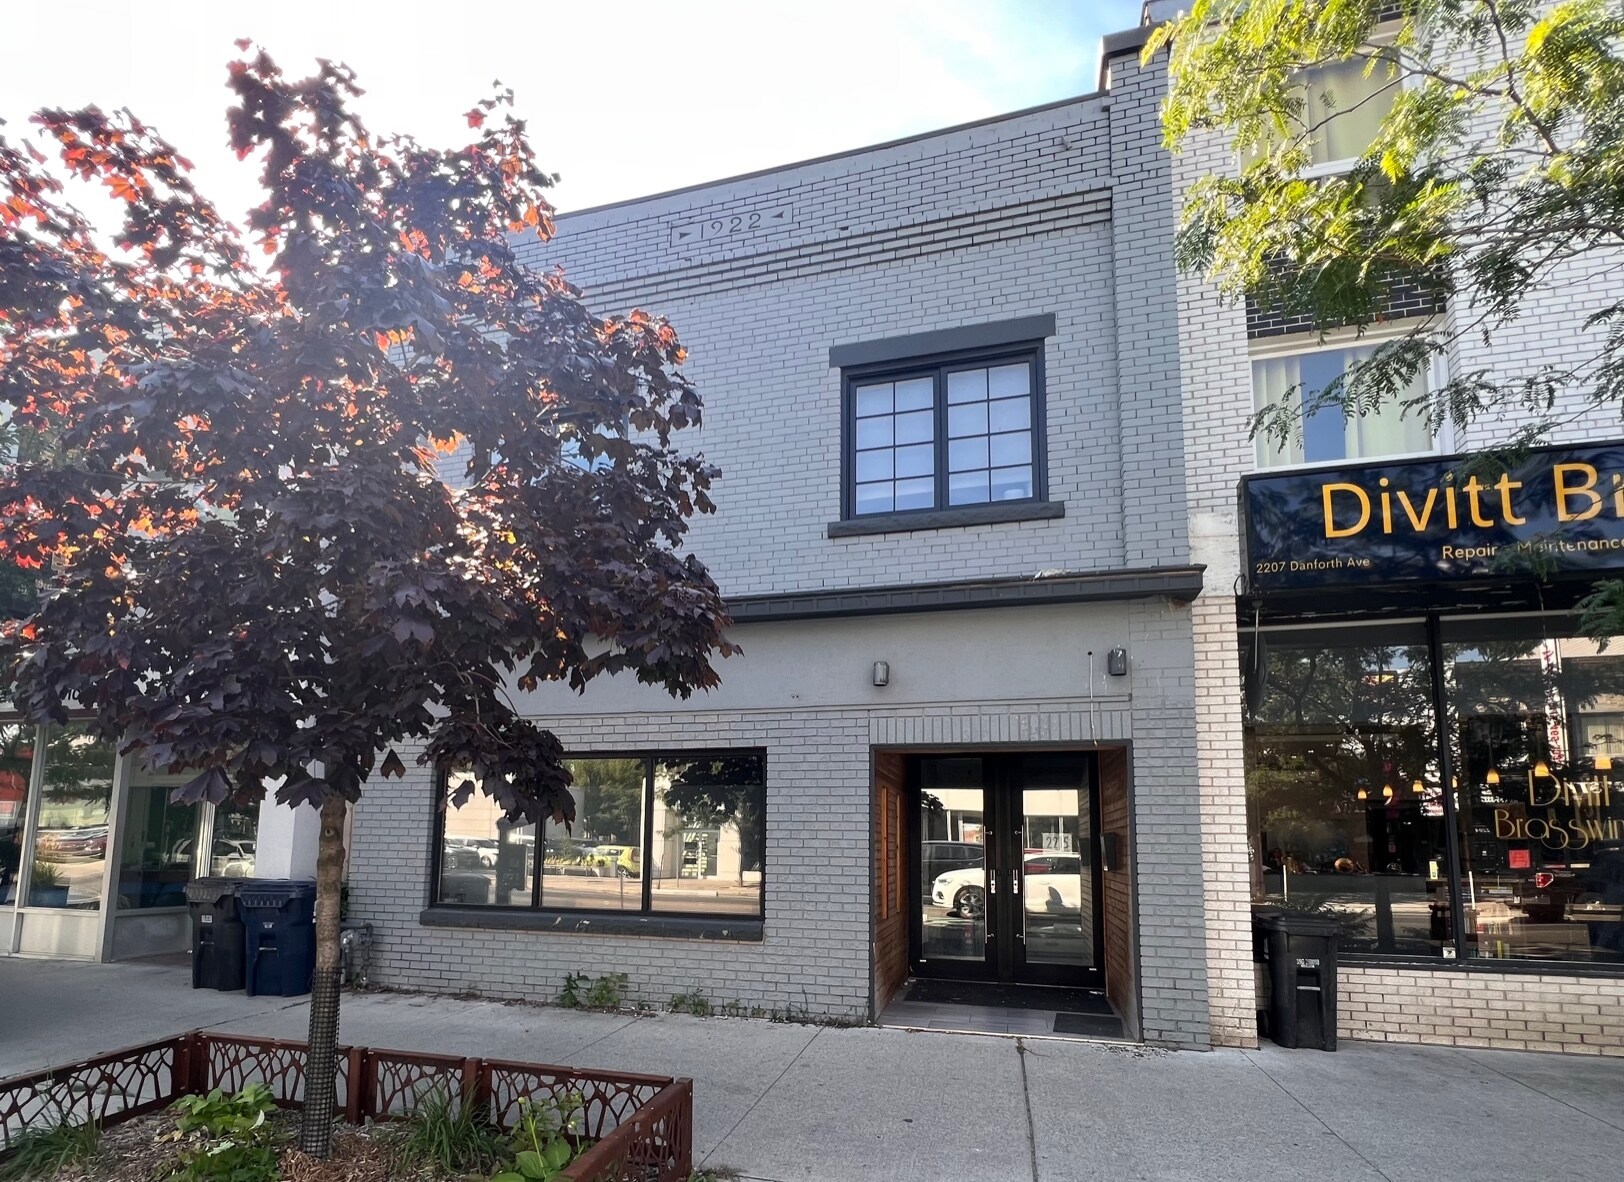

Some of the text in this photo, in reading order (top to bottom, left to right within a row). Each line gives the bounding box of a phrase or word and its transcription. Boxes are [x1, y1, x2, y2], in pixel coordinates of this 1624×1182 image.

[700, 212, 762, 239] 1922
[1322, 472, 1526, 538] Divitt
[1442, 538, 1624, 561] Repair Mintenanc
[1256, 557, 1370, 574] 2207 Danforth Ave
[1046, 836, 1069, 849] 225
